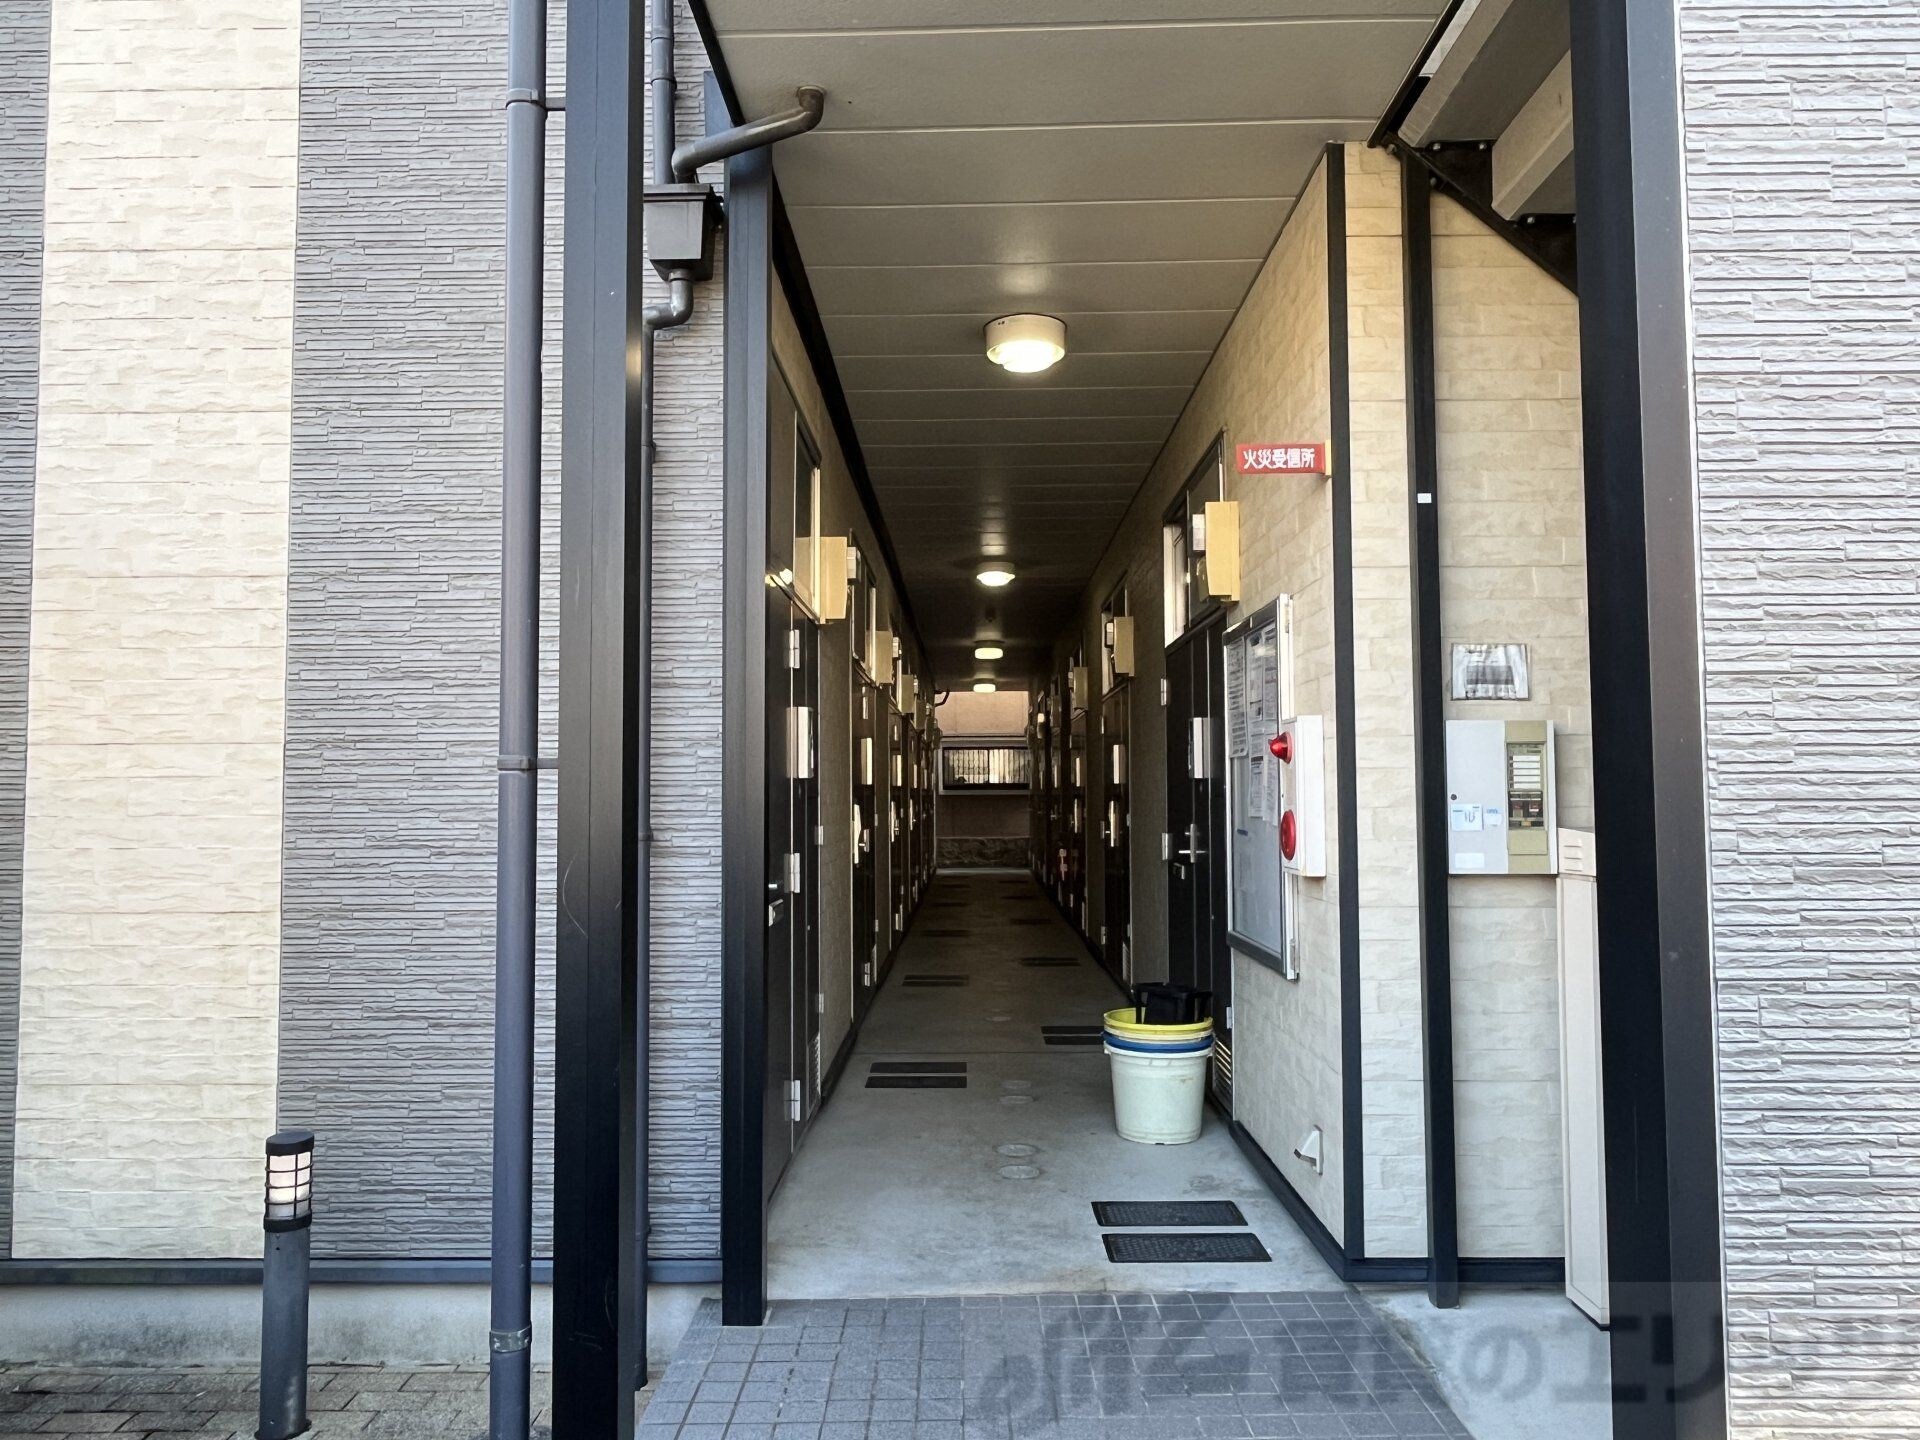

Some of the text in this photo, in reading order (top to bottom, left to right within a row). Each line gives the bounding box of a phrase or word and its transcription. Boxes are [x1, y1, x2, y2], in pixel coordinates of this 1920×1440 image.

[1243, 447, 1316, 470] 火災受信所
